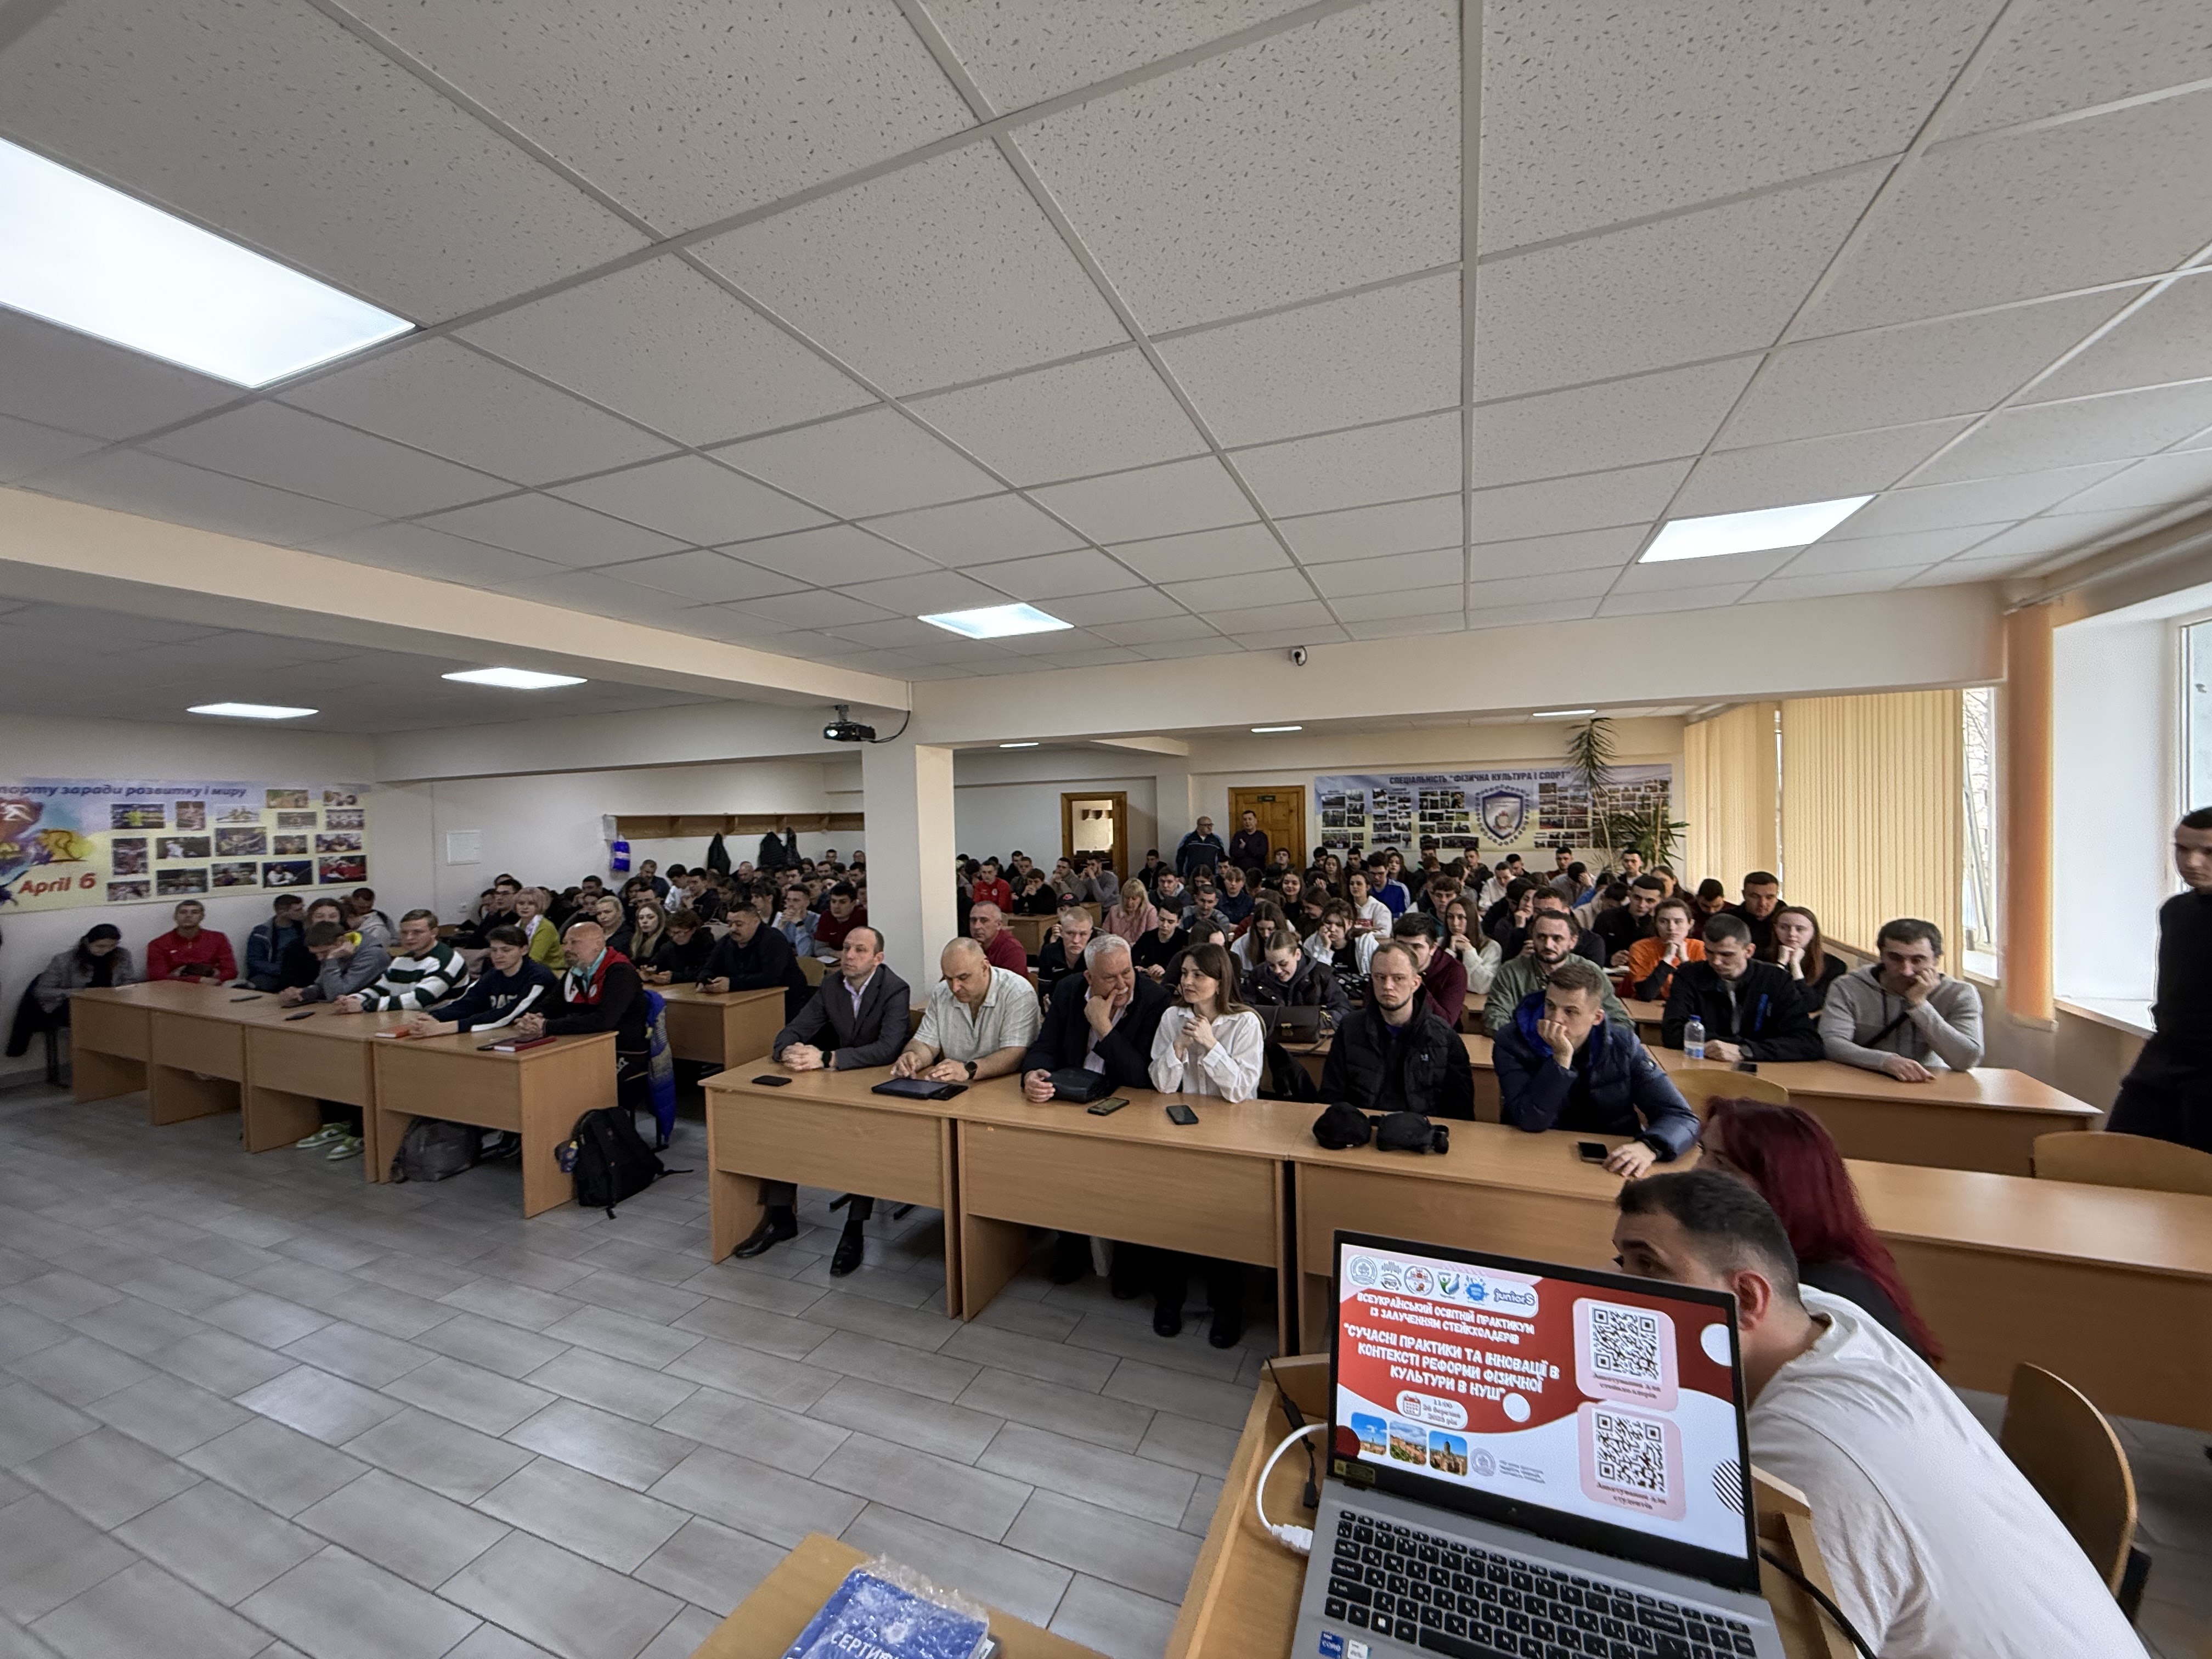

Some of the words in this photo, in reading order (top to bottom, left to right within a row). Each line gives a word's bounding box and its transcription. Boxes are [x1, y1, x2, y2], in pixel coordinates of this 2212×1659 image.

[61, 785, 122, 797] заради
[125, 787, 202, 798] розвитку
[211, 788, 247, 798] миру
[1389, 775, 1448, 785] СПЕЦІАЛЬНІСТЬ
[1491, 771, 1532, 781] КУЛЬТУРА
[18, 877, 72, 896] April
[80, 872, 97, 889] 6
[1357, 1292, 1433, 1315] ВСЕУКРАЇНСЬКИЙ
[1434, 1306, 1475, 1323] ОСВІТНІЙ
[1476, 1314, 1535, 1335] ПРАКТИКУМ
[1380, 1308, 1441, 1330] ЗАЛУЧЕННЯМ
[1344, 1322, 1397, 1346] "СУЧАСНІ
[1399, 1334, 1463, 1359] ПРАКТИКИ
[1464, 1347, 1483, 1364] ТА
[1485, 1351, 1549, 1378] ІННОВАЦІЇ
[1549, 1364, 1560, 1380] В
[1358, 1341, 1420, 1367] КОНТЕКСТІ
[1422, 1355, 1481, 1380] РЕФОРМИ
[1483, 1369, 1544, 1393] ФІЗИЧНОЇ
[1390, 1364, 1455, 1391] КУЛЬТУРИ
[1458, 1379, 1468, 1393] В
[831, 1630, 900, 1659] СЕРТИ
